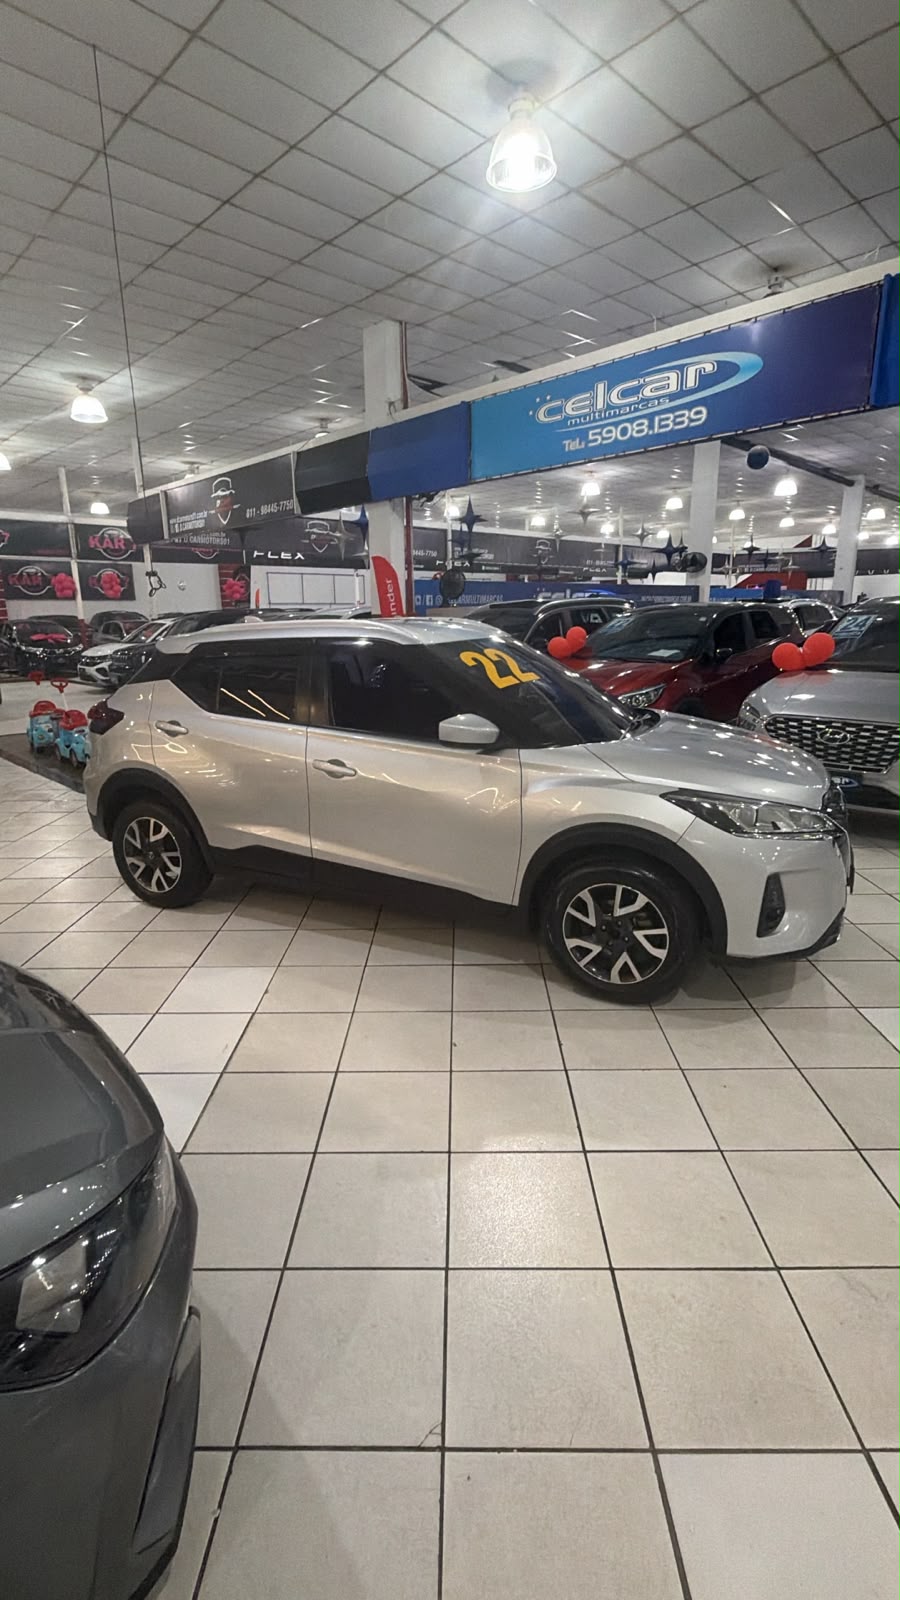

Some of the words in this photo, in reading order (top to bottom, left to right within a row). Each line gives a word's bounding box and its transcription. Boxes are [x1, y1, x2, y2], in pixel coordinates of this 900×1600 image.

[535, 360, 718, 424] celcar
[567, 397, 670, 426] multimarcas
[587, 406, 708, 447] 5908.1339
[252, 550, 305, 560] FLEX
[459, 647, 541, 689] 22
